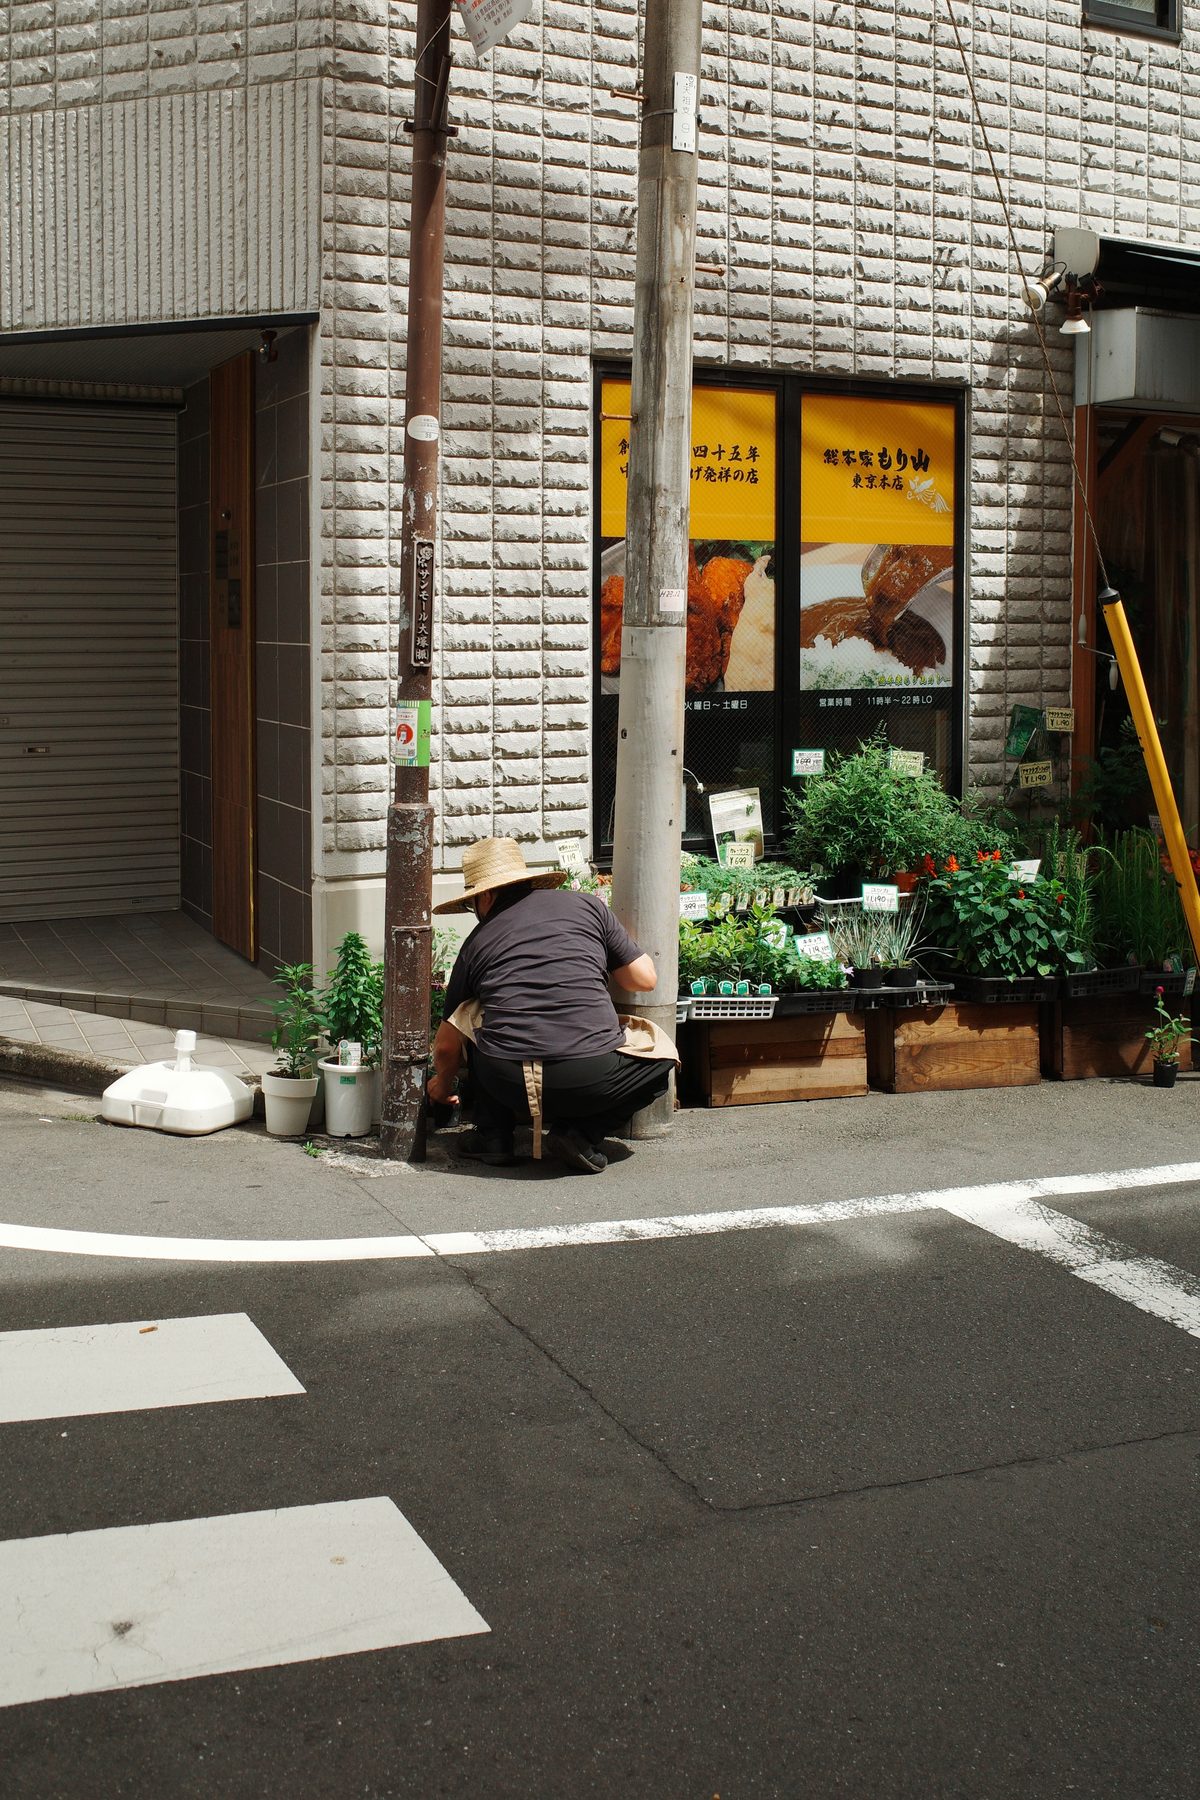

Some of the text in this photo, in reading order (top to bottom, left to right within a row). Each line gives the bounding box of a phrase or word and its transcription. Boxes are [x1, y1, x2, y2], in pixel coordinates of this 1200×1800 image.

[692, 443, 761, 462] 四十五年
[823, 446, 930, 472] 総本家もり山
[851, 473, 904, 490] 東京本店
[819, 697, 852, 707] 営業時間
